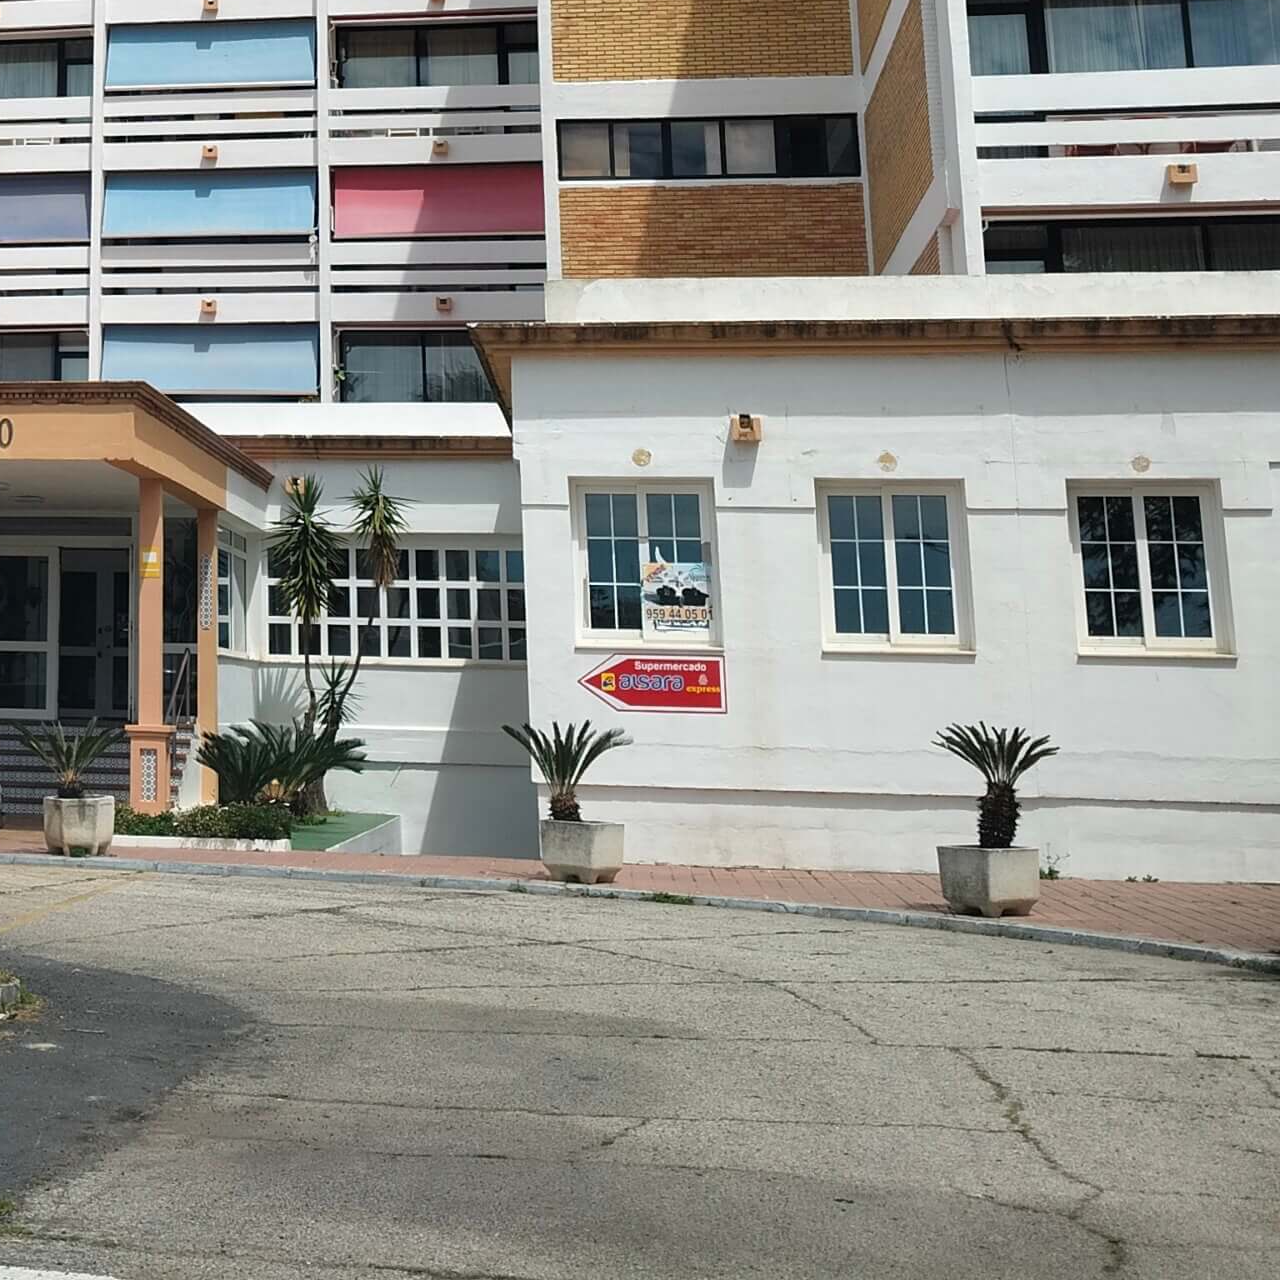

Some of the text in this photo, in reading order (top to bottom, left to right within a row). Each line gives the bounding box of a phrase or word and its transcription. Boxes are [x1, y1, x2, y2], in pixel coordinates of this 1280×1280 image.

[646, 607, 713, 620] 959 44 05 01
[634, 661, 707, 672] Supermercado
[619, 673, 720, 694] alsara express
